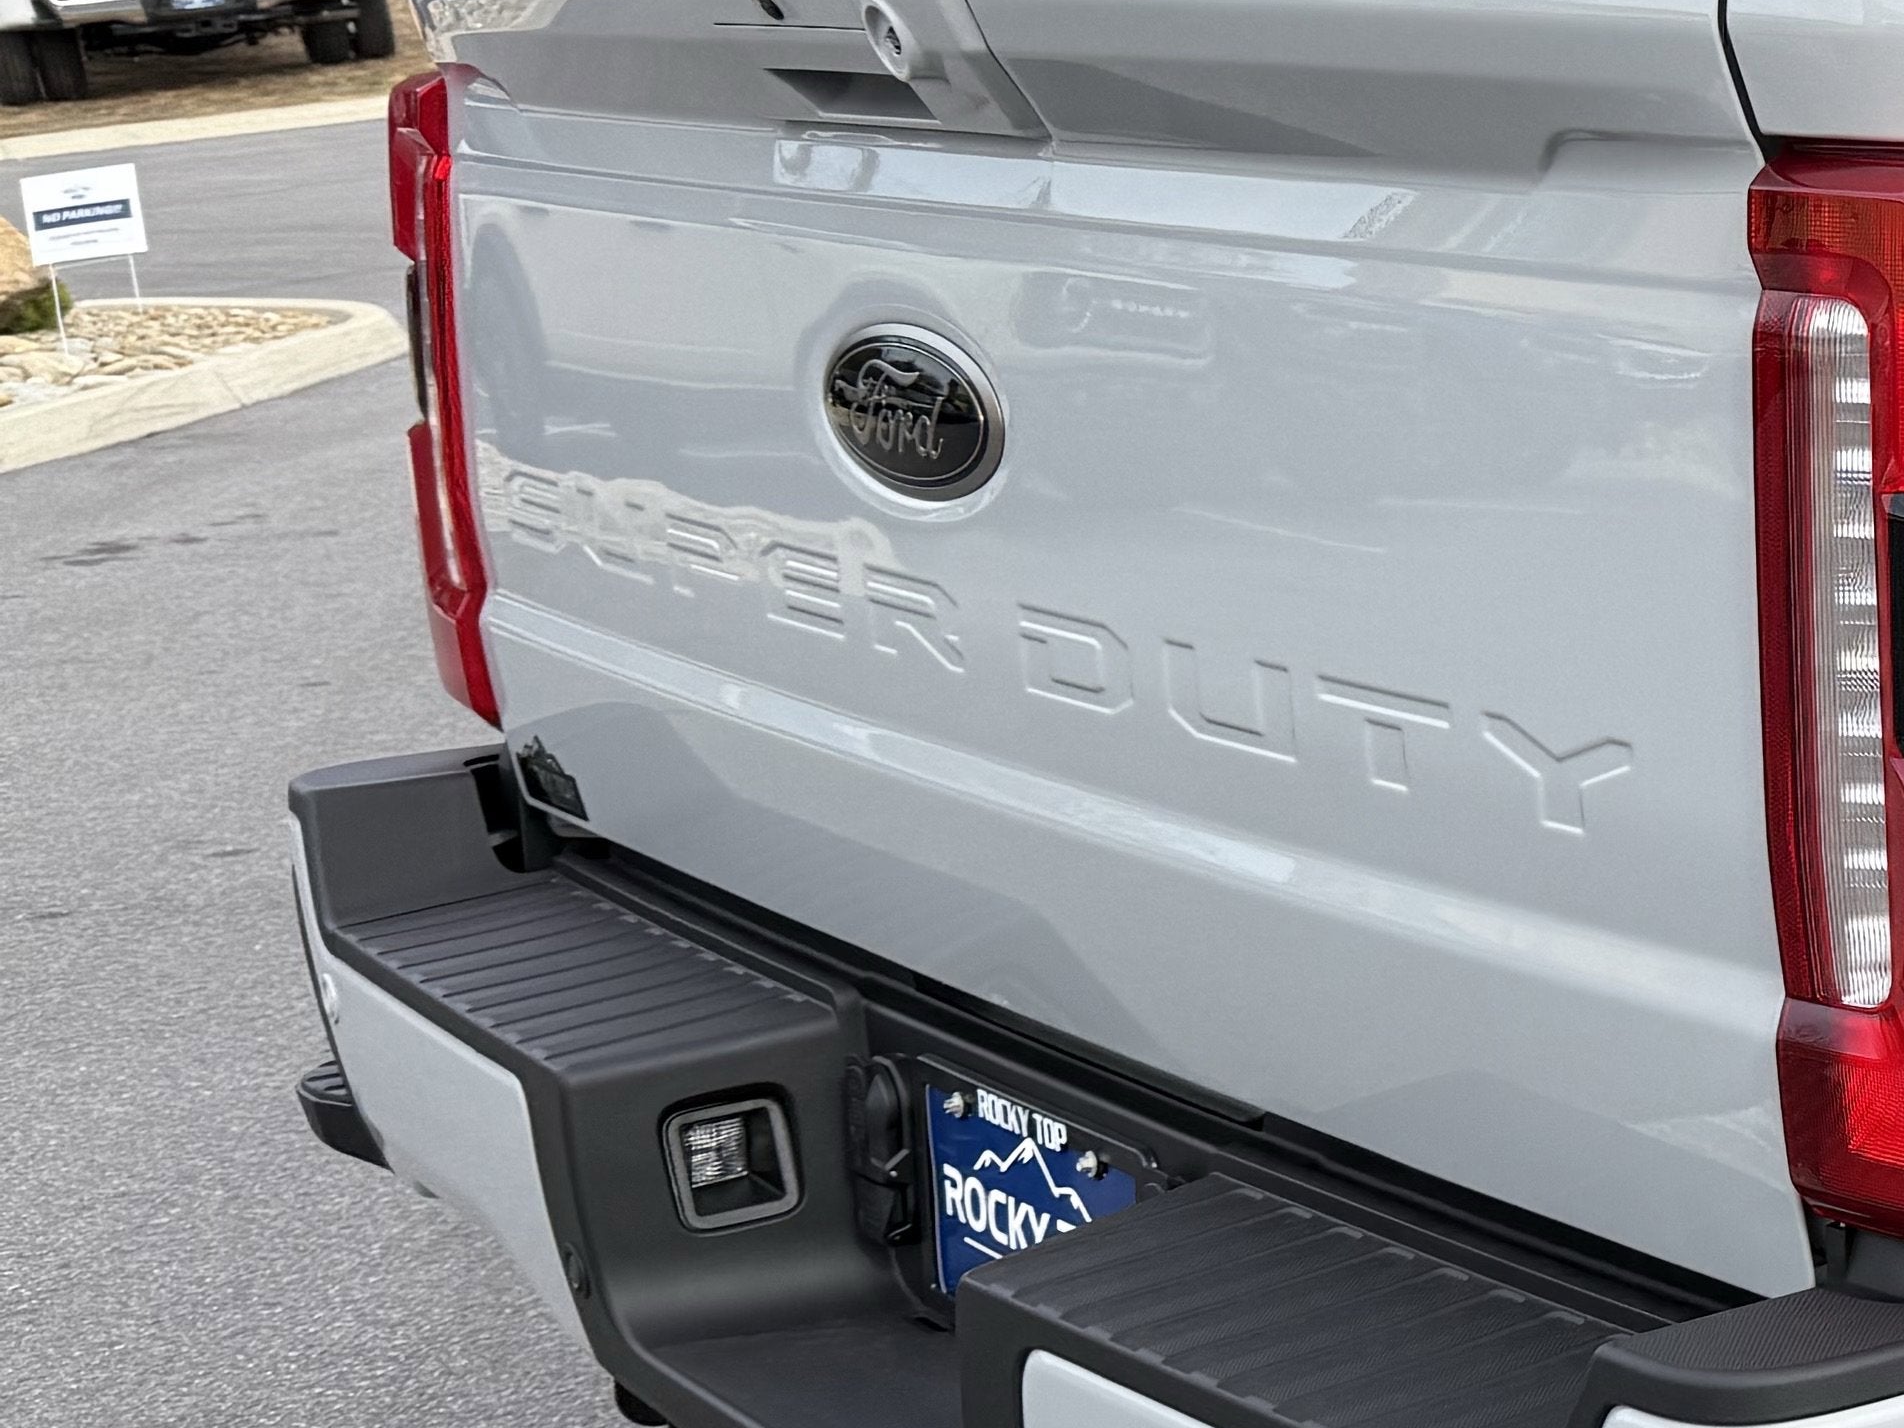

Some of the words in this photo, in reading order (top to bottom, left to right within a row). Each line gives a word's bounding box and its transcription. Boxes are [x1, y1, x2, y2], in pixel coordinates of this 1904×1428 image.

[42, 212, 61, 225] NO
[834, 358, 945, 461] Ford
[503, 469, 966, 674] SUPER
[1016, 602, 1634, 838] DUTY
[976, 1088, 1030, 1138] ROCKY
[1032, 1112, 1068, 1152] TOP
[943, 1163, 1051, 1250] ROCKY
